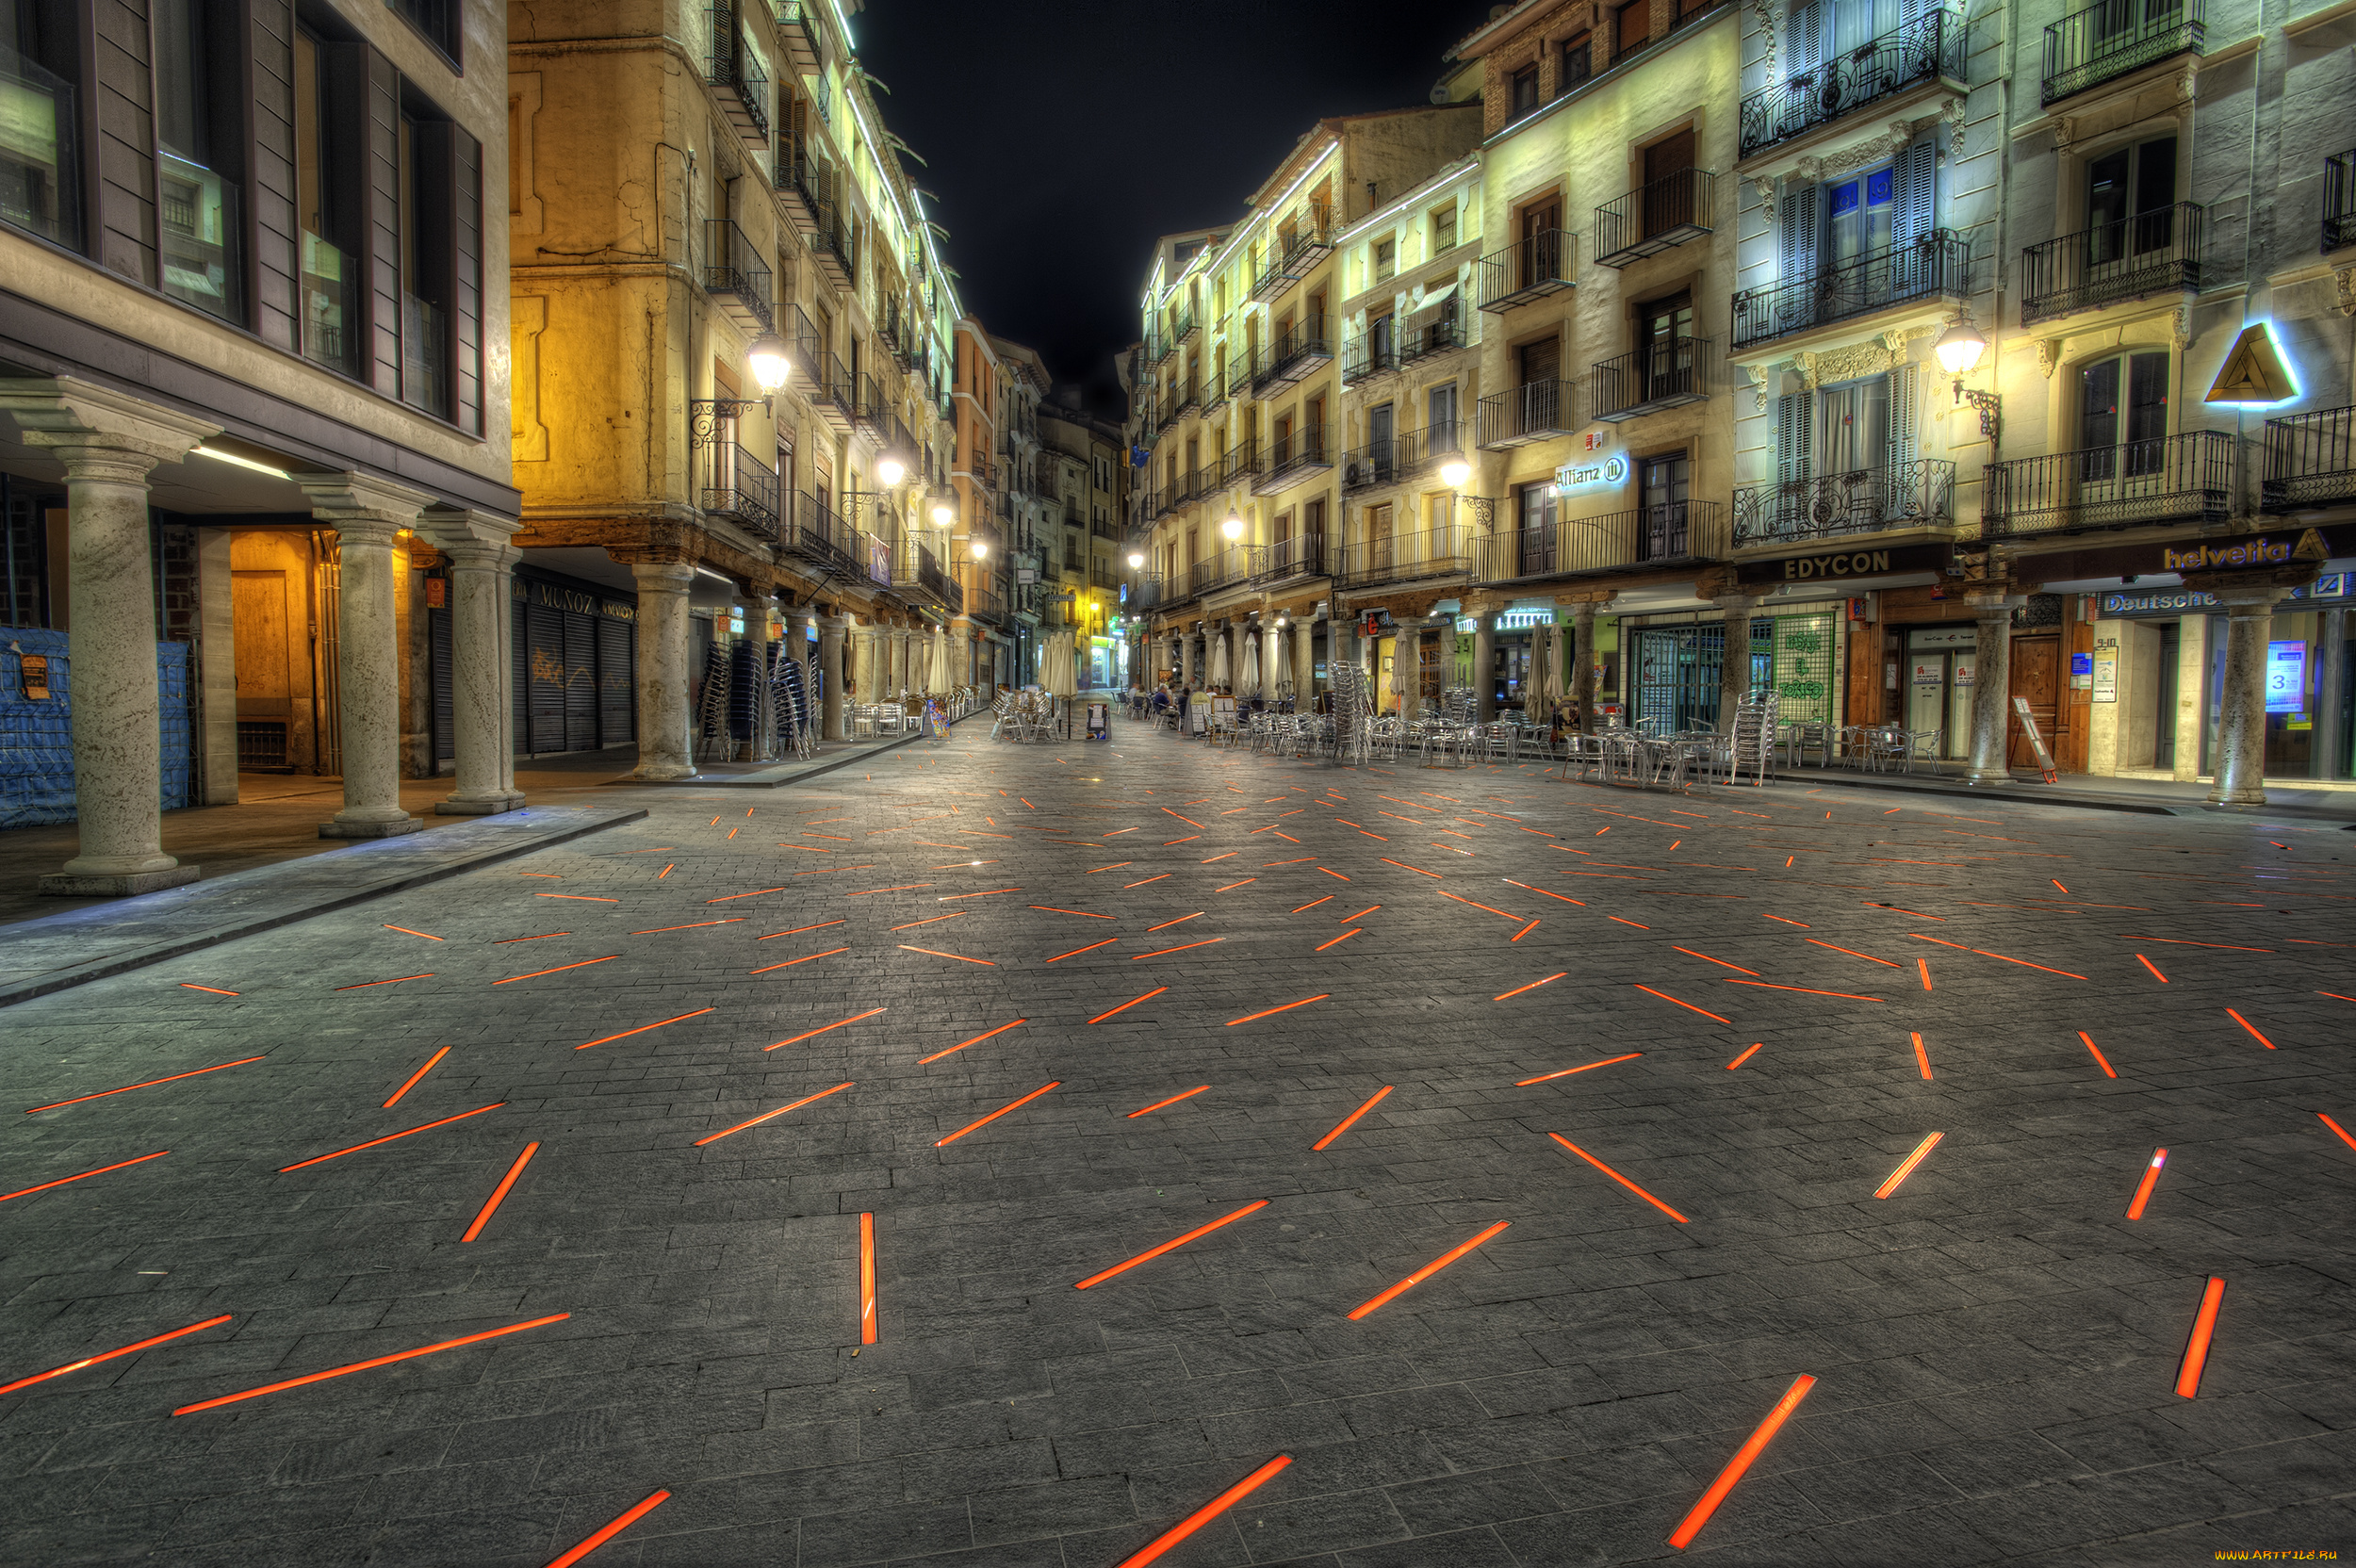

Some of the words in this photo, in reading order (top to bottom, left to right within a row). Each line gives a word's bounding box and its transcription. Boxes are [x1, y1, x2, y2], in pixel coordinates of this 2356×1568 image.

[1555, 467, 1600, 488] Allianz
[1785, 550, 1890, 580] EDYCON
[2165, 539, 2289, 569] helvetia
[512, 580, 527, 597] ERIA
[539, 583, 593, 615] MUÑOZ
[2104, 590, 2217, 612] Deutsche
[2272, 675, 2285, 690] 3
